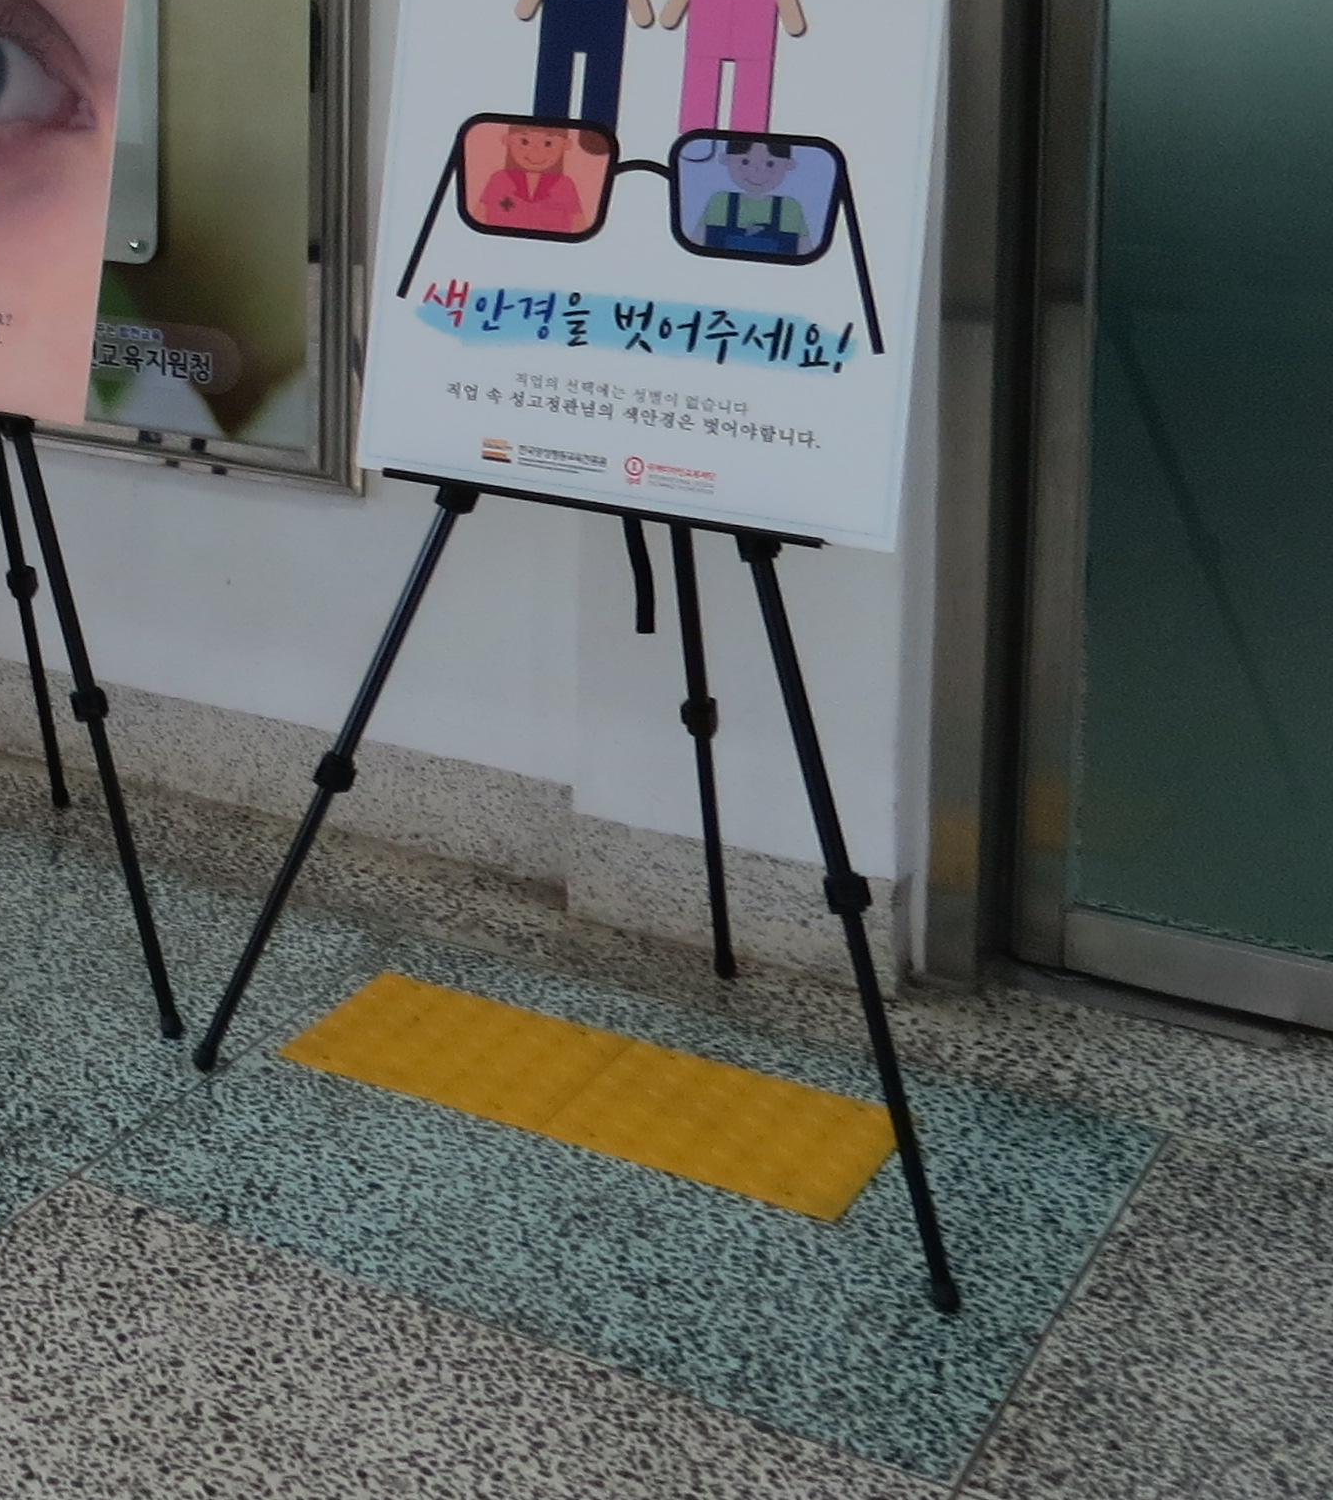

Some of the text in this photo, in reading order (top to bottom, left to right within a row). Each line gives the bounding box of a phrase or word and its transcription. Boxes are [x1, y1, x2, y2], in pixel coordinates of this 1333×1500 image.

[422, 278, 856, 374] 색안경을 벗어주세요!
[446, 381, 479, 402] 직업
[484, 386, 503, 404] 속
[509, 389, 615, 421] 성고정관념의
[623, 403, 696, 432] 색안경은
[515, 370, 750, 416] 직업의 선택에는 성별이 없습니다
